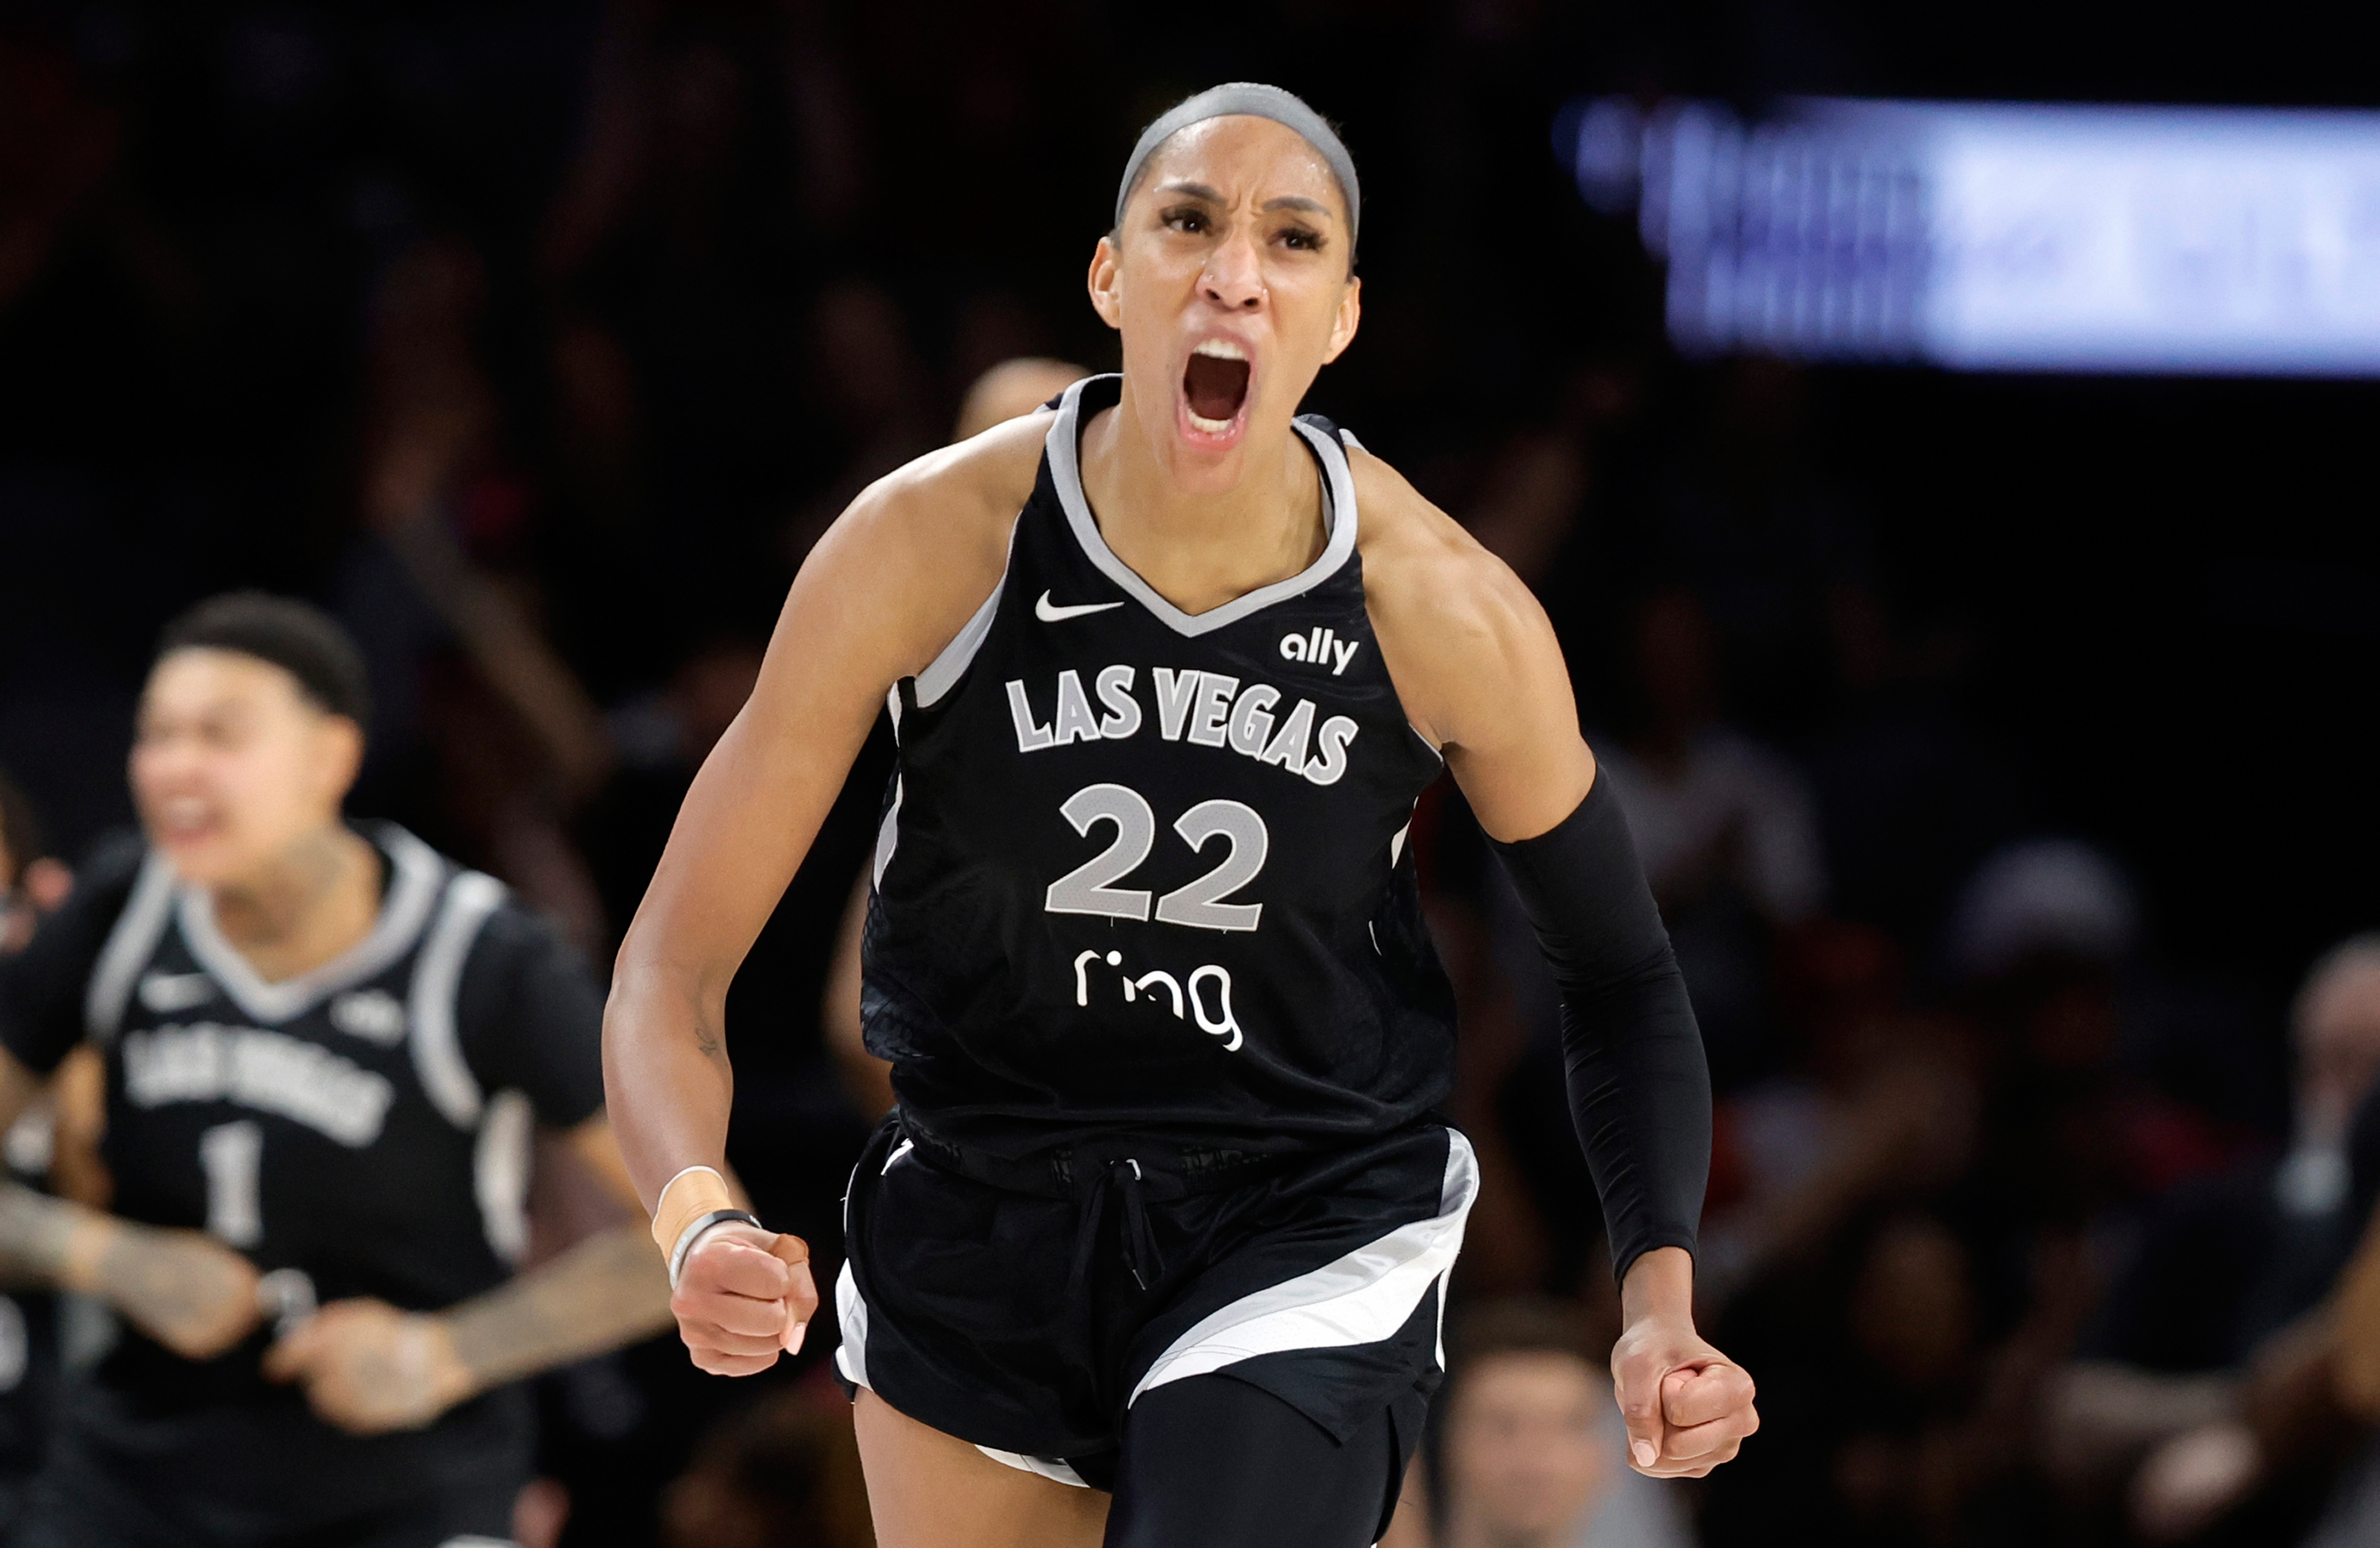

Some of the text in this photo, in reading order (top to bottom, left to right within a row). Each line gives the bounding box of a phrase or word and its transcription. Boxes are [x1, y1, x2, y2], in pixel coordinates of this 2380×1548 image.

[1279, 627, 1359, 676] ally
[1005, 665, 1359, 785] LAS VEGAS
[1044, 783, 1268, 931] 22
[1074, 950, 1243, 1052] ring
